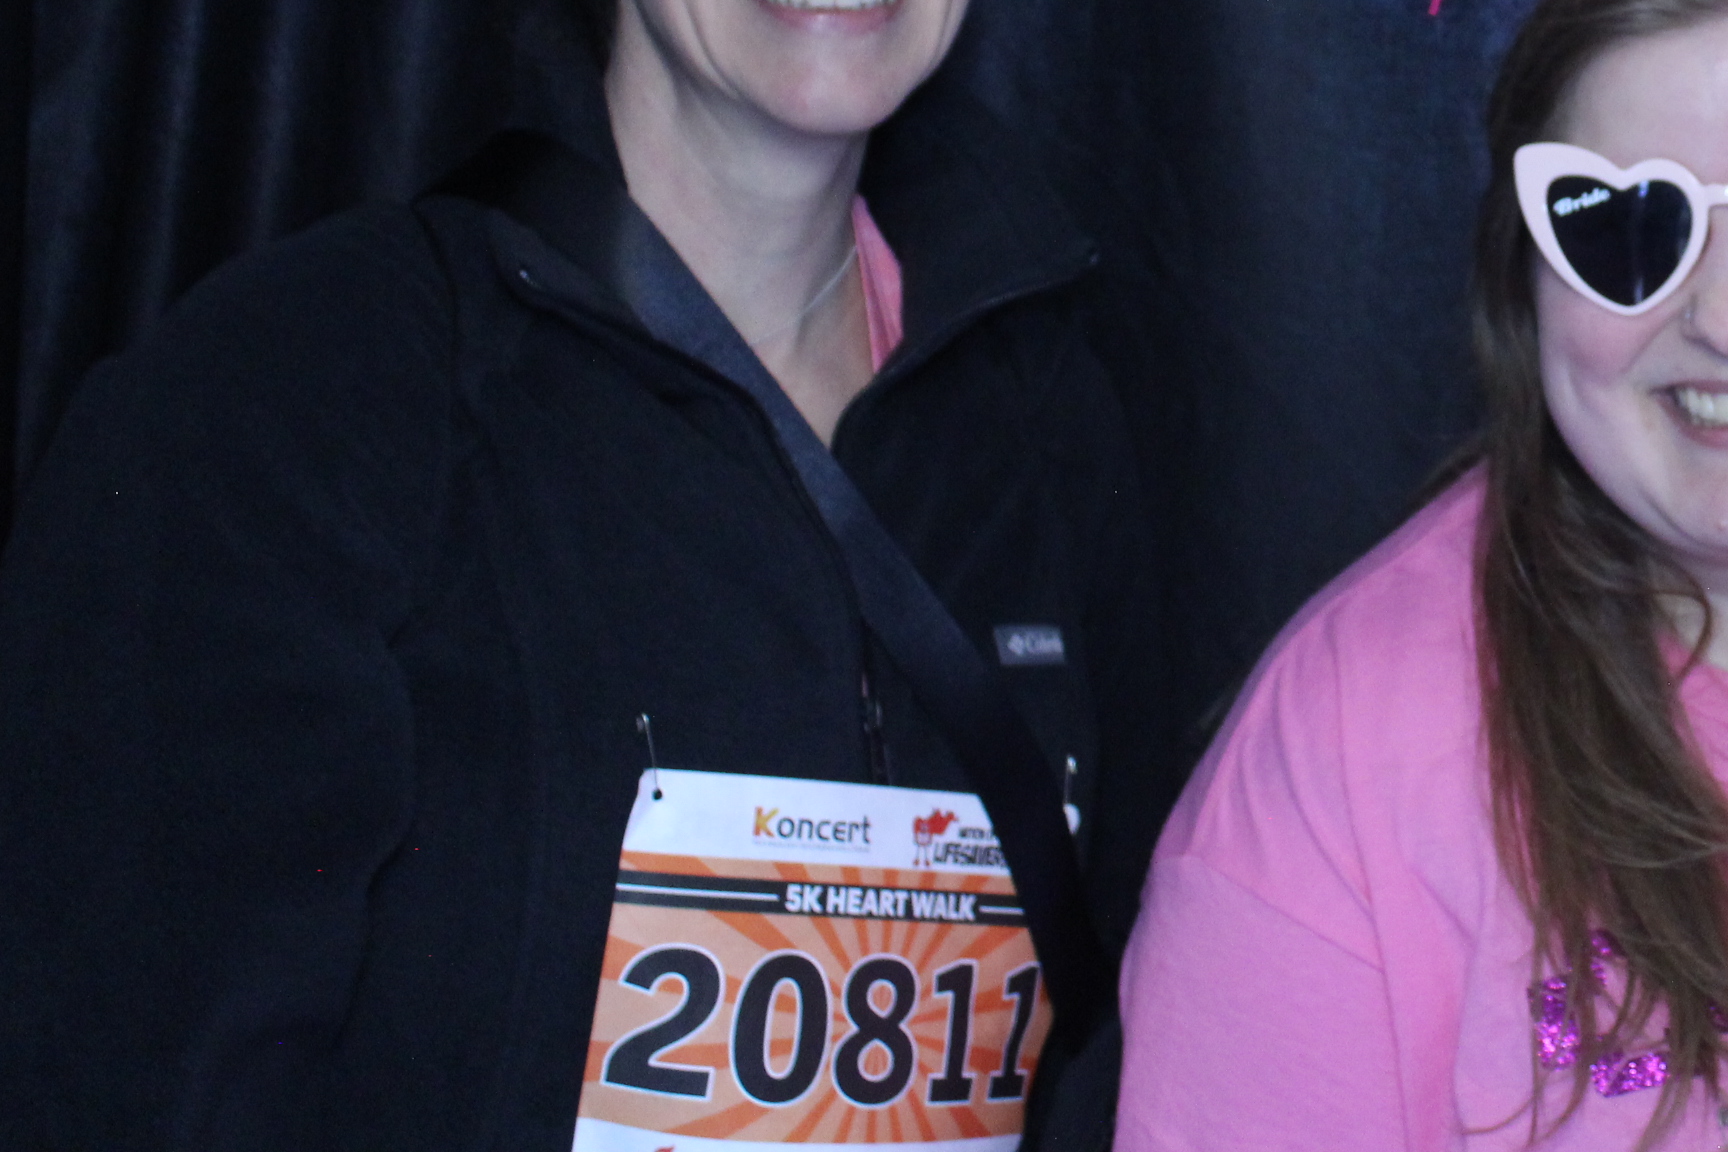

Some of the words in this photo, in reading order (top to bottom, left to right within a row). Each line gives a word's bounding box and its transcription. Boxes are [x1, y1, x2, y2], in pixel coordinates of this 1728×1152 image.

[1552, 187, 1611, 217] Bride
[753, 806, 871, 844] Koncert
[784, 882, 824, 915] 5K
[825, 885, 909, 917] HEART
[911, 890, 977, 921] WALK
[602, 943, 1041, 1108] 20811
